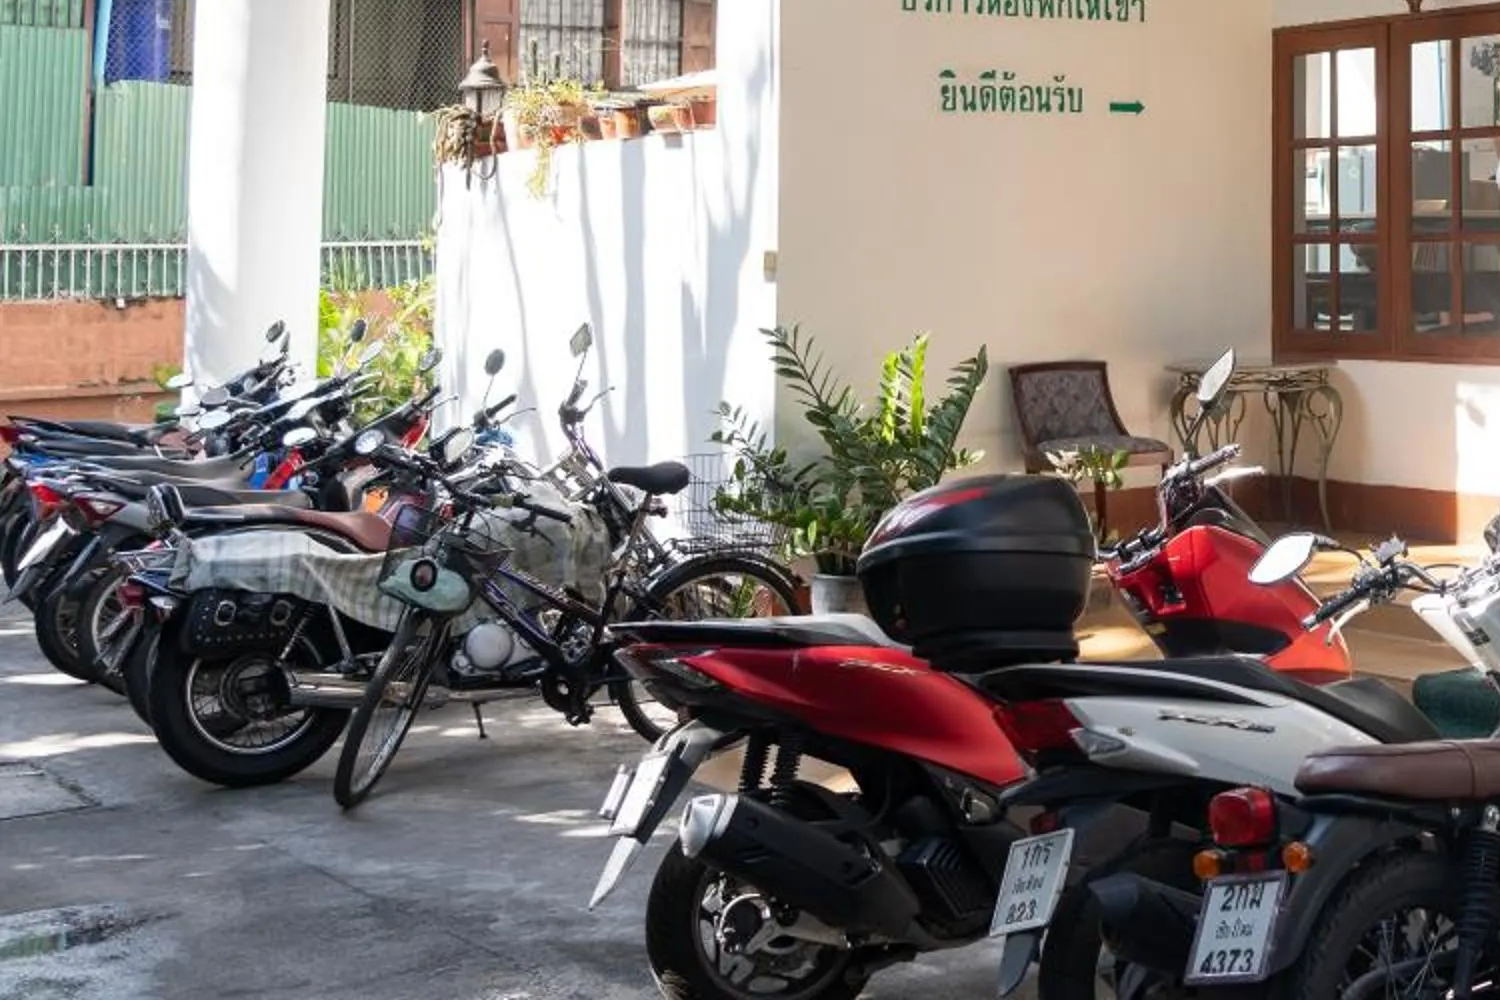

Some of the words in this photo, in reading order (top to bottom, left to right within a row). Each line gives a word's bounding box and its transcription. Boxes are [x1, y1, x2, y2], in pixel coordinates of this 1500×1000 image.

[939, 69, 1083, 113] ยินดีต้อนรับ
[1200, 948, 1254, 973] 4373
